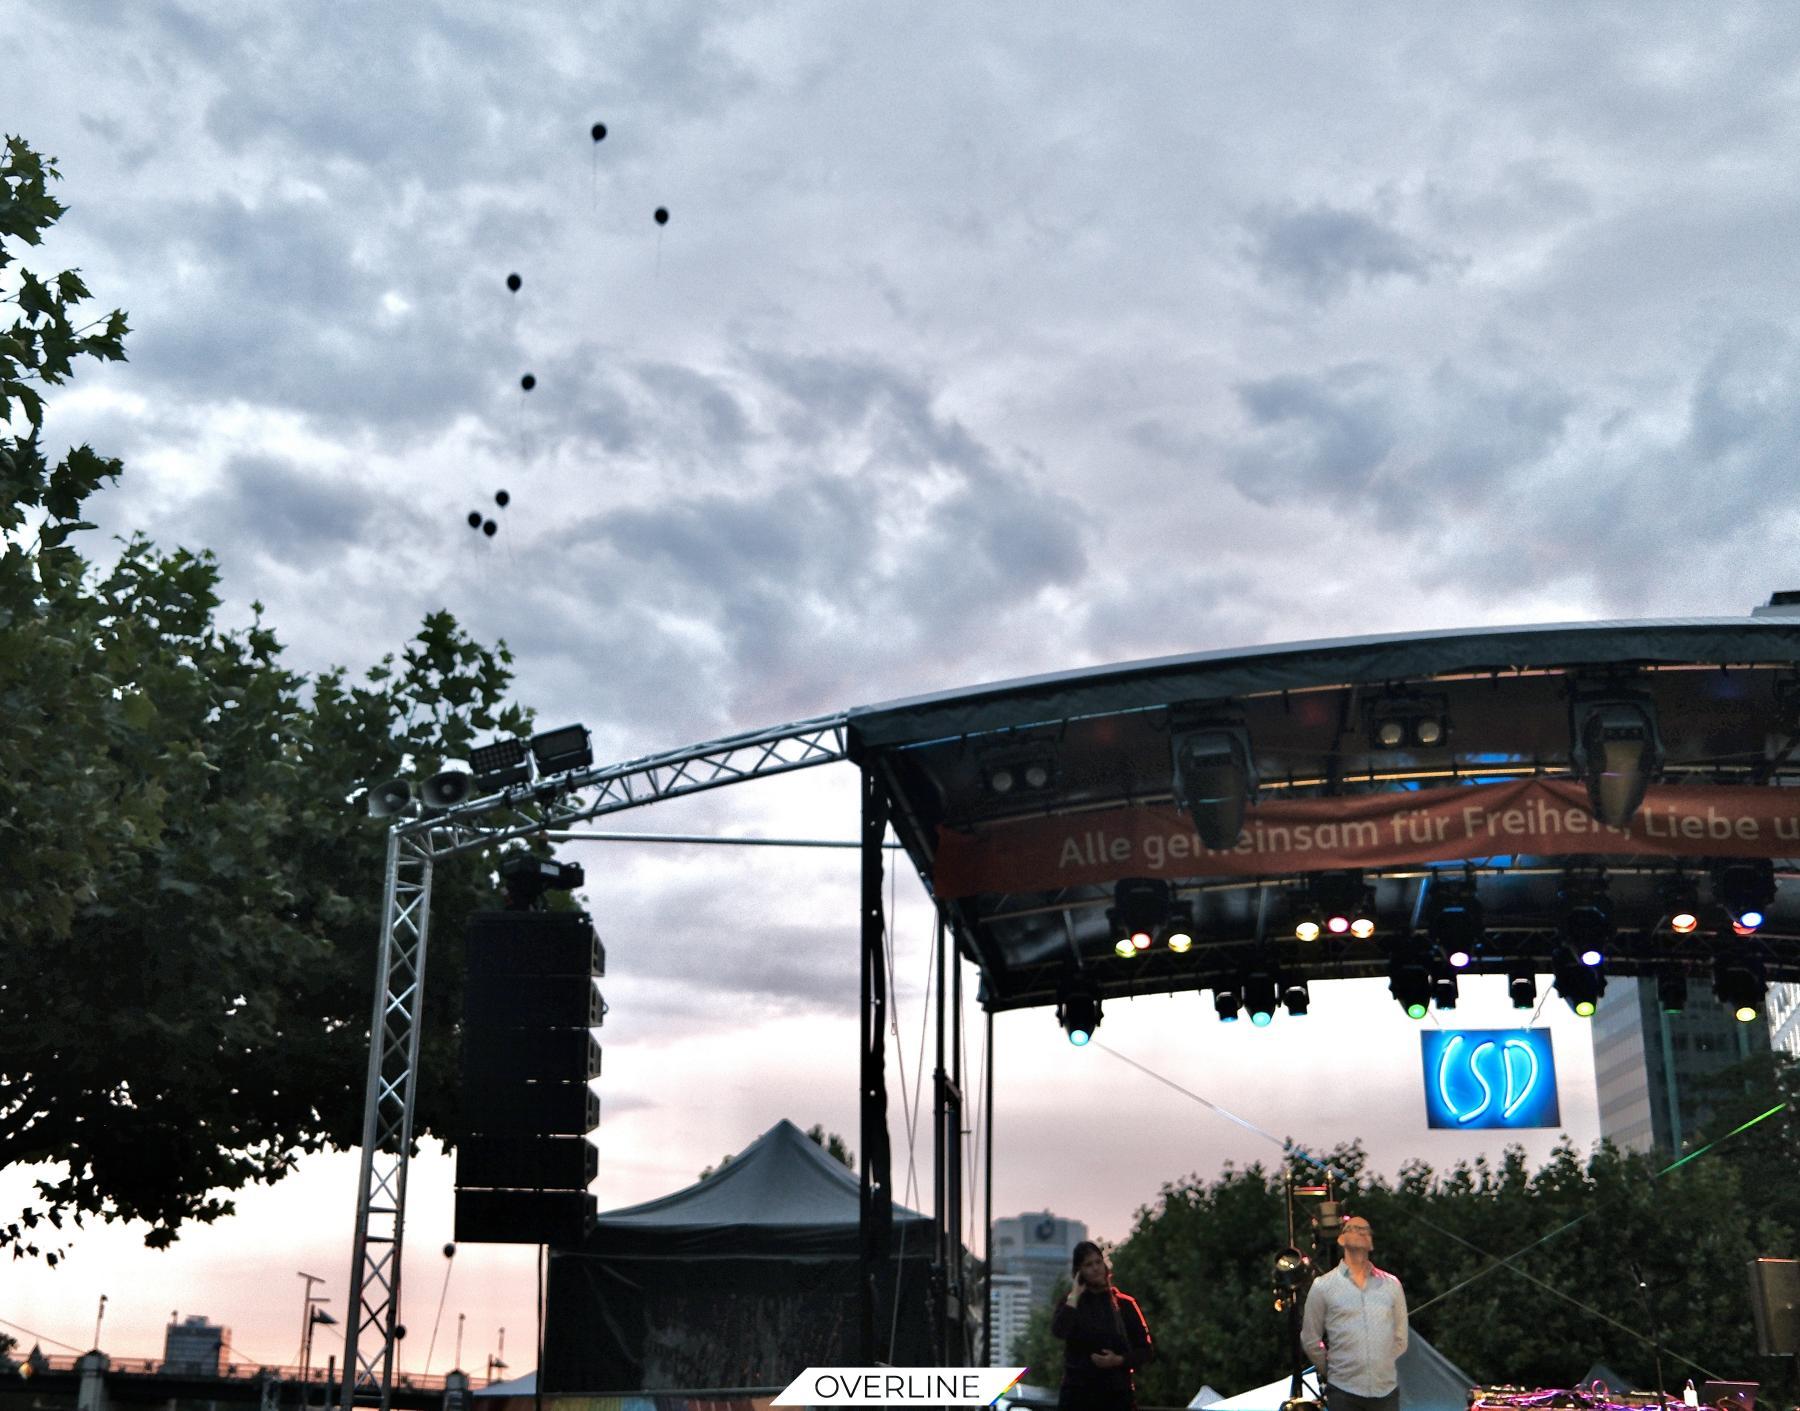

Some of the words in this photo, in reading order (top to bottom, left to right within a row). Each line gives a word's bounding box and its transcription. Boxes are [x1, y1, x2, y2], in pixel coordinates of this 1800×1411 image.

[1059, 832, 1131, 869] Alle
[1389, 809, 1451, 846] für
[1644, 805, 1760, 840] Liebe
